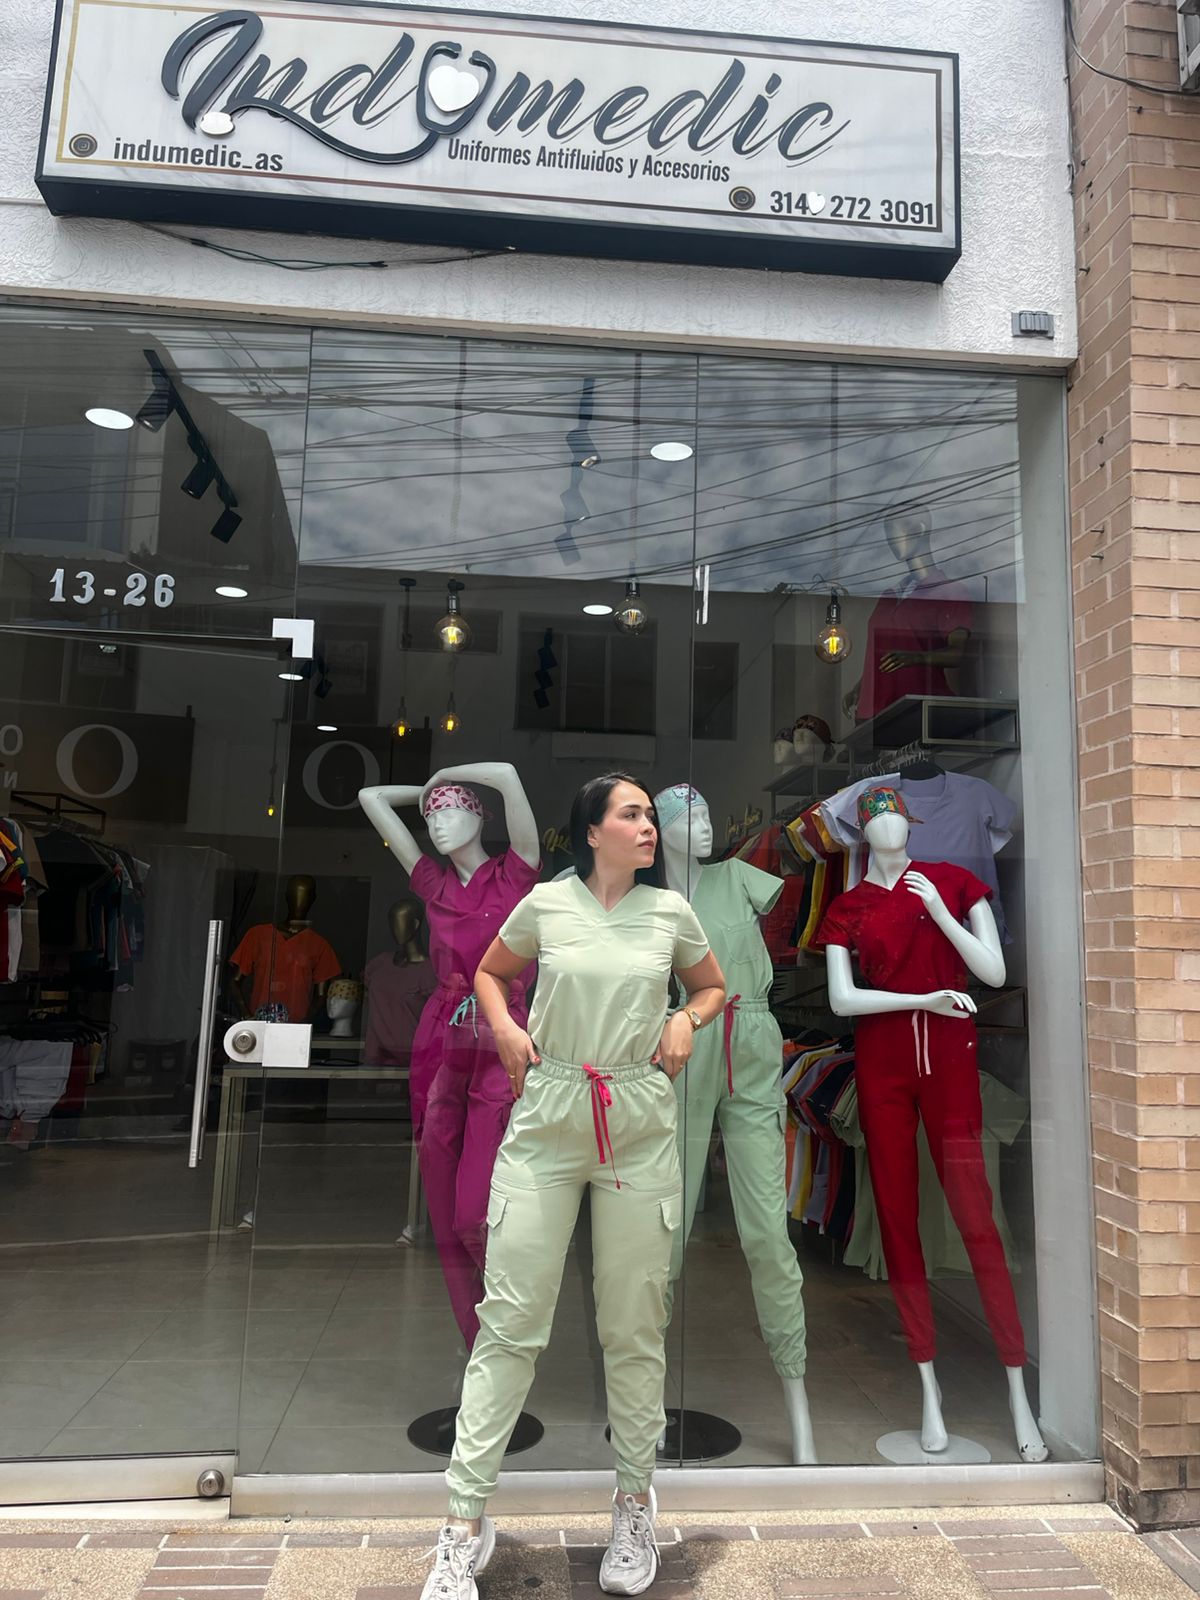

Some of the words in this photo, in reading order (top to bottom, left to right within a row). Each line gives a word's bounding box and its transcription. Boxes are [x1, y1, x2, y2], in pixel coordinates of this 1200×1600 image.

[113, 137, 283, 172] indumedic_as
[447, 138, 531, 165] Uniformes
[536, 145, 624, 174] Antifluidos
[628, 158, 638, 179] y
[642, 155, 730, 182] Accesorios
[770, 190, 808, 214] 314
[830, 195, 871, 220] 272
[880, 199, 934, 225] 3091
[49, 568, 176, 608] 13-26
